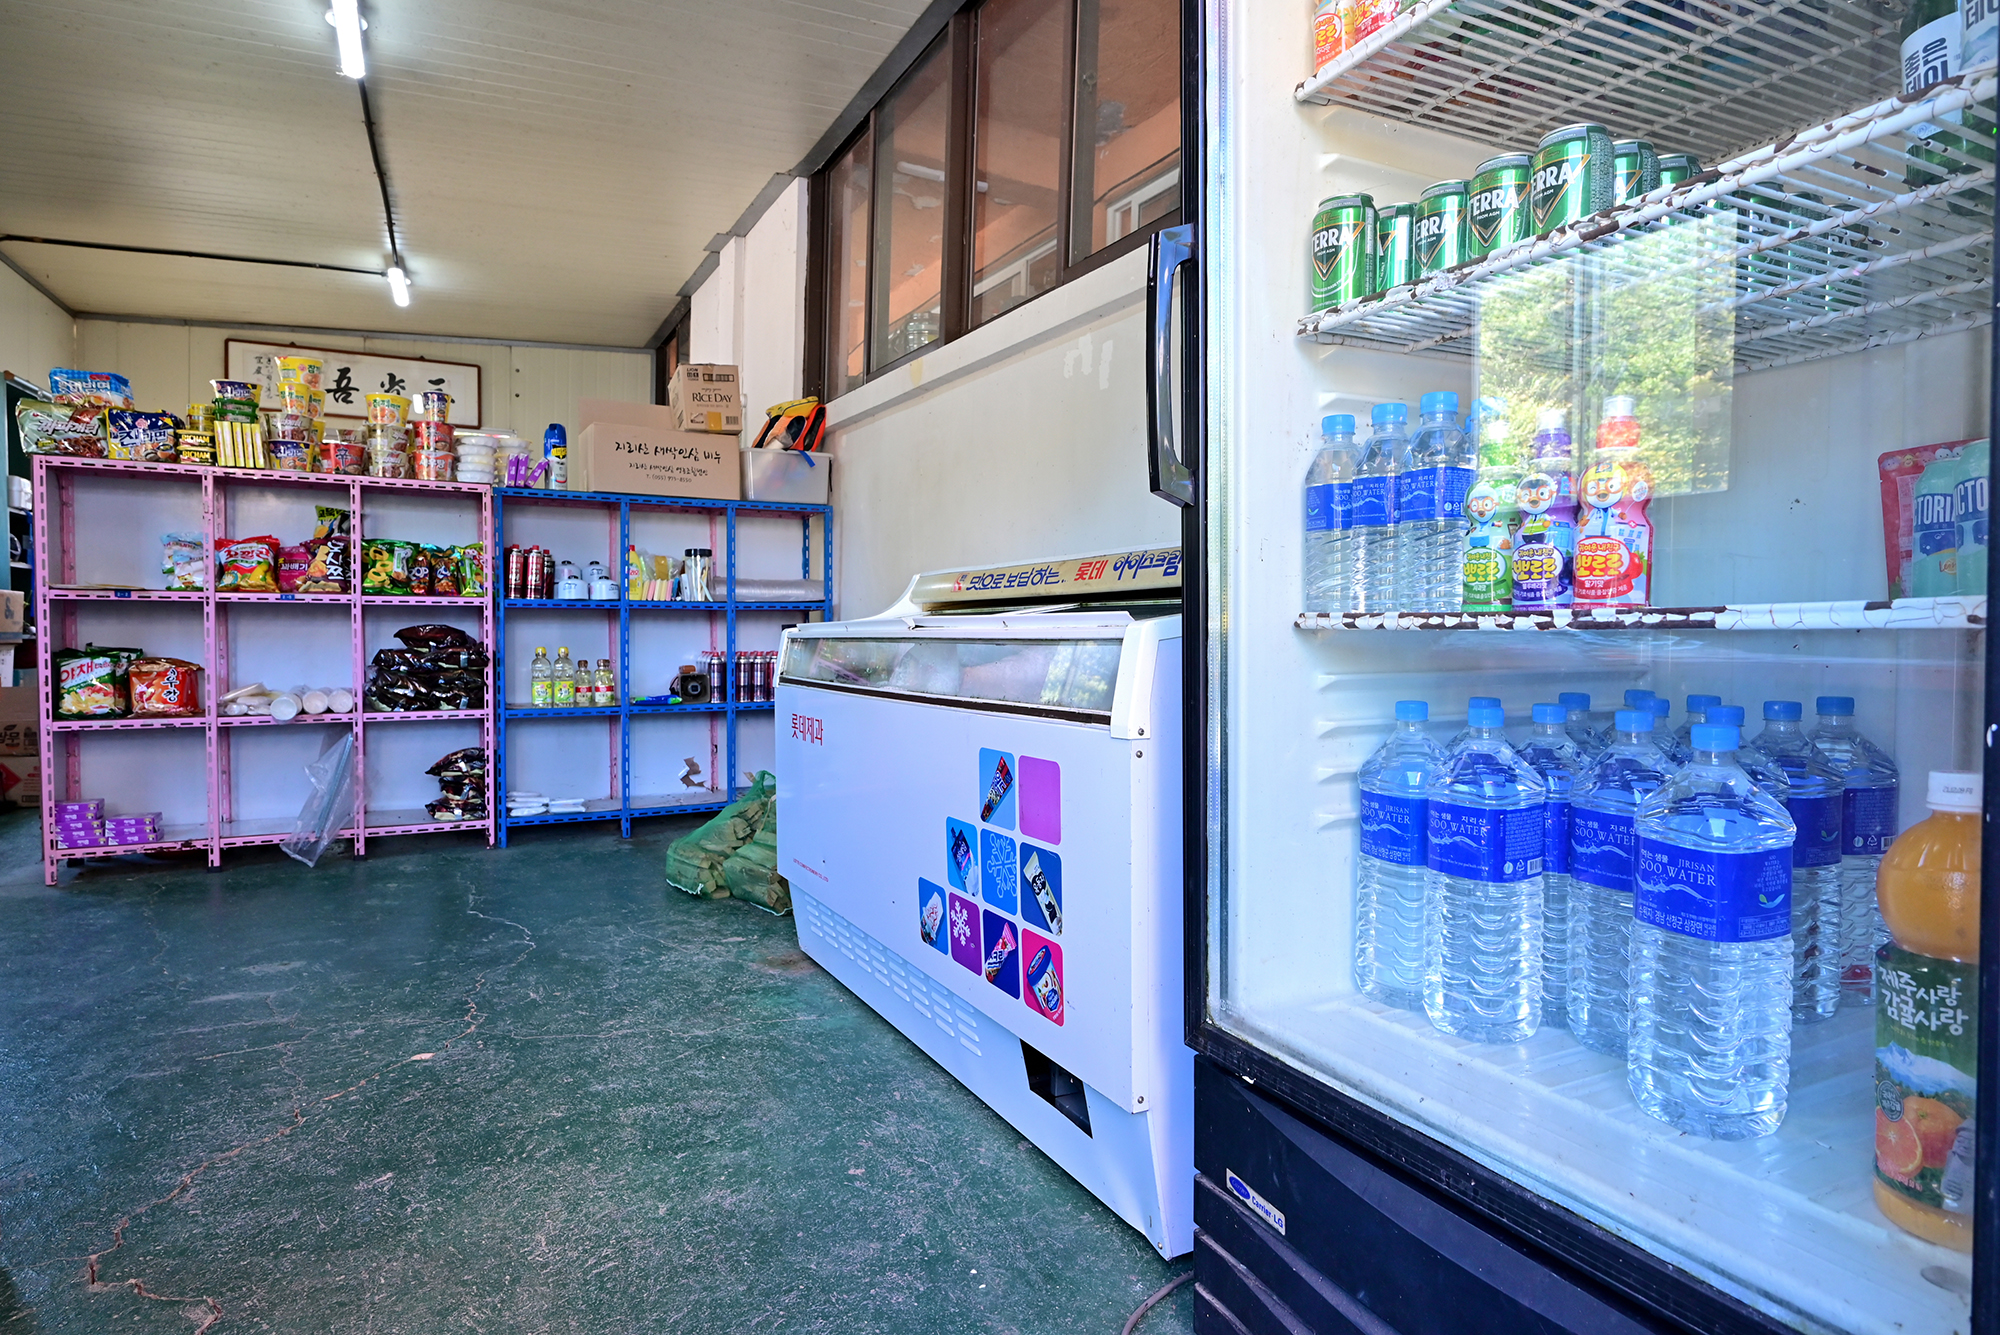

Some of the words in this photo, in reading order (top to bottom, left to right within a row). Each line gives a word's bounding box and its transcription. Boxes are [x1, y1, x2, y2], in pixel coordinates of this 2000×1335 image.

[1313, 23, 1337, 47] 로로
[1531, 162, 1576, 194] ERRA
[1416, 213, 1456, 242] ERRA
[692, 392, 713, 402] RICE
[714, 393, 733, 402] DAY
[37, 419, 100, 436] 짜파게티
[119, 428, 169, 448] 진라면
[181, 434, 210, 443] RICHAM
[182, 450, 211, 460] RICHAM
[615, 441, 650, 455] 지리산
[654, 446, 700, 462] 새싹인삼
[703, 450, 722, 464] 비누
[628, 462, 647, 470] 지리산
[1363, 488, 1386, 497] WATER
[1411, 481, 1435, 489] WATER
[1914, 493, 1956, 528] TORI
[224, 546, 270, 560] 꼬깔콘
[1466, 552, 1480, 561] 귀여운
[1518, 549, 1535, 558] 귀여운
[1535, 547, 1555, 557] 내친구
[1578, 543, 1598, 552] 귀여운
[1598, 543, 1621, 552] 내친구
[280, 562, 309, 571] 꽈배기
[966, 573, 1006, 591] 맛으로
[1074, 559, 1109, 582] 롯데
[1112, 550, 1182, 581] 아이스크림
[1463, 561, 1501, 583] 뽀로로
[1512, 558, 1557, 581] 뽀로로
[1576, 553, 1624, 578] 뽀로로
[1521, 582, 1548, 590] 블루베리맛
[1584, 580, 1605, 588] 딸기맛
[60, 660, 94, 683] 야채
[160, 667, 180, 703] 새우깡
[791, 713, 824, 747] 롯데제과
[1361, 805, 1376, 817] SOO
[1378, 810, 1411, 825] WATER
[1385, 804, 1410, 814] JIRISAN
[1430, 809, 1440, 818] 먹는
[1440, 812, 1452, 821] 샘물
[1461, 815, 1486, 826] 지리산
[1429, 818, 1447, 830] SOO
[1449, 822, 1488, 838] WATER
[1574, 817, 1586, 827] 먹는
[1586, 820, 1599, 830] 샘물
[1609, 824, 1635, 835] 지리산
[1574, 826, 1594, 839] SOO
[1640, 848, 1653, 860] 먹는
[1654, 852, 1669, 864] 샘물
[1640, 858, 1662, 874] SOO
[1666, 865, 1717, 887] WATER
[1677, 858, 1715, 873] JIRISAN
[1654, 910, 1666, 925] 경남
[1666, 914, 1683, 930] 산청군
[1683, 919, 1703, 935] 삼장면
[1880, 966, 1963, 1007] 제주사랑
[1881, 988, 1970, 1036] 감귤사랑
